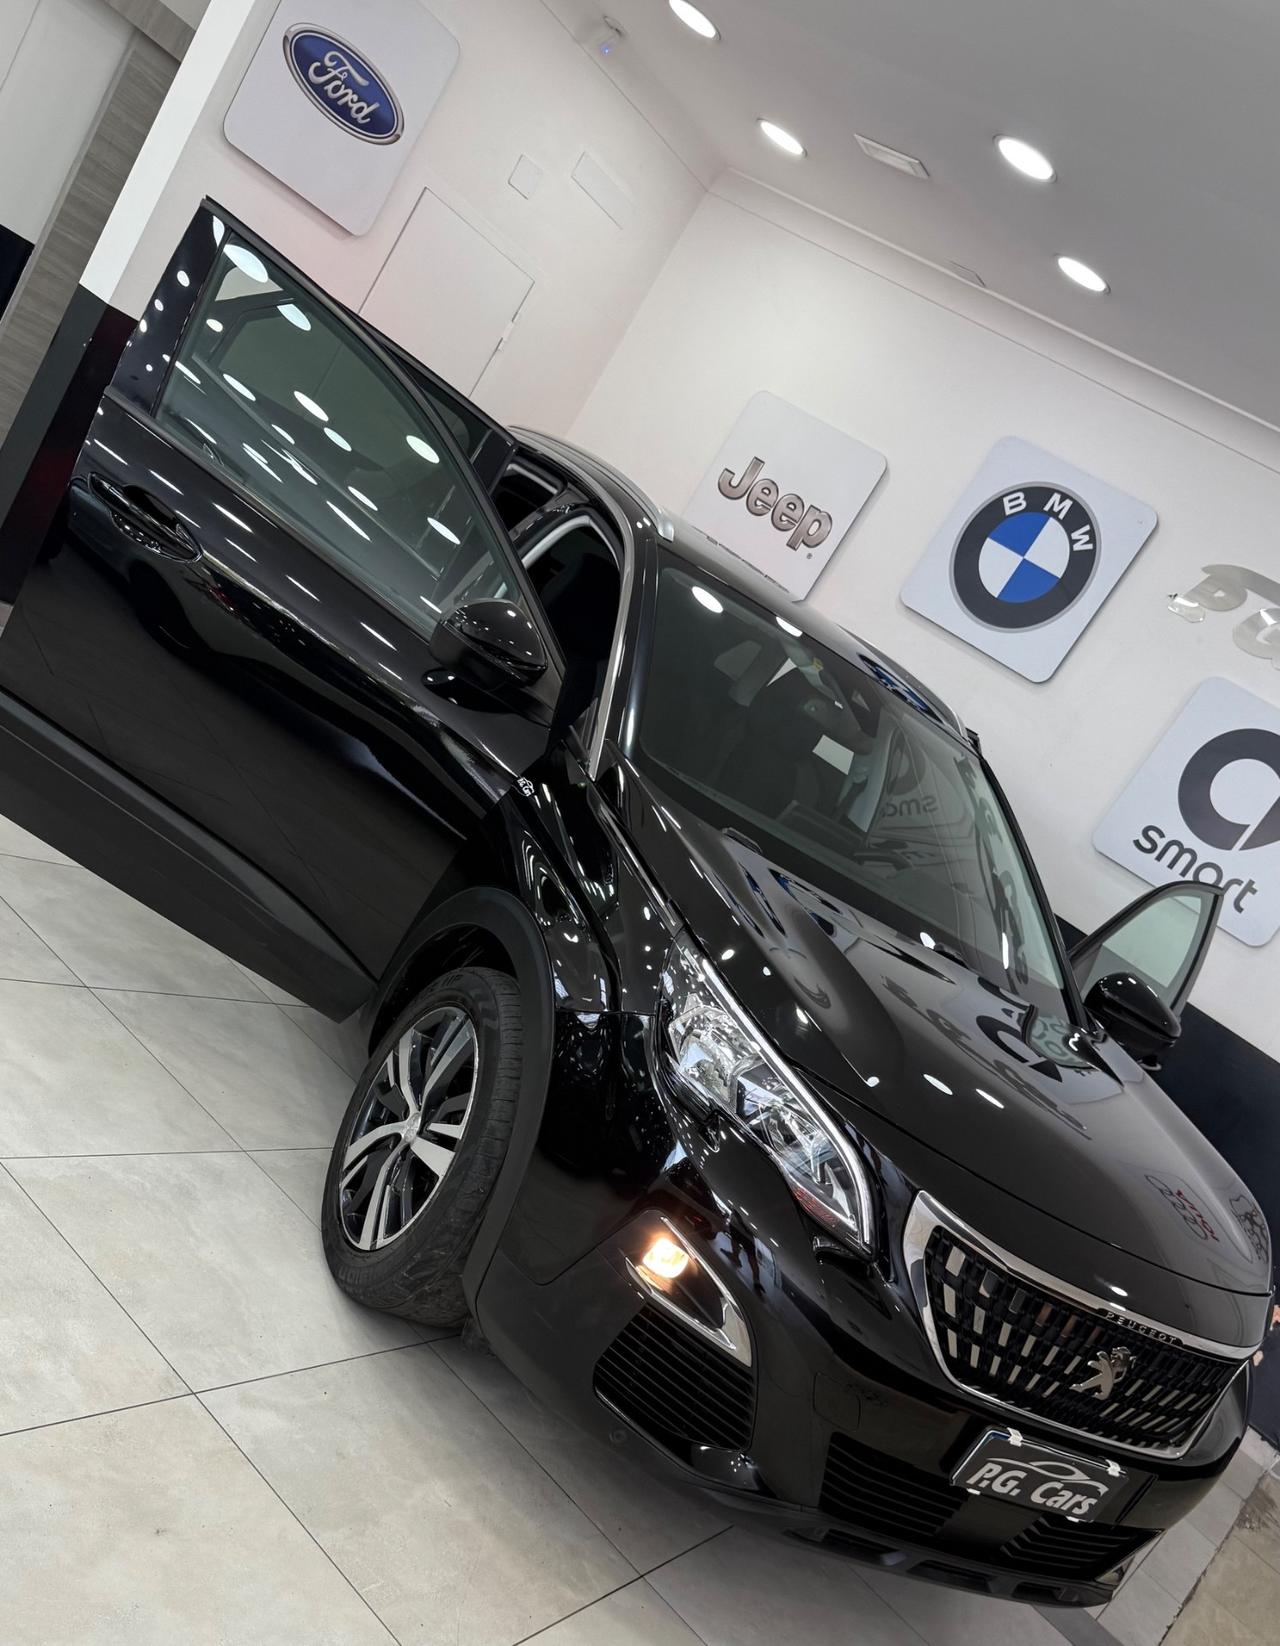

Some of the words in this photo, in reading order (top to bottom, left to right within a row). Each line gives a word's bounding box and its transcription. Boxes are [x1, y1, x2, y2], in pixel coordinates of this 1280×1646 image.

[308, 50, 380, 124] Ford
[717, 455, 833, 552] Jeep
[1002, 491, 1094, 552] BMW
[1132, 824, 1259, 915] smart
[1105, 1311, 1178, 1345] PEUGEOT
[965, 1462, 1028, 1498] P.G.
[1030, 1481, 1099, 1516] Cars
